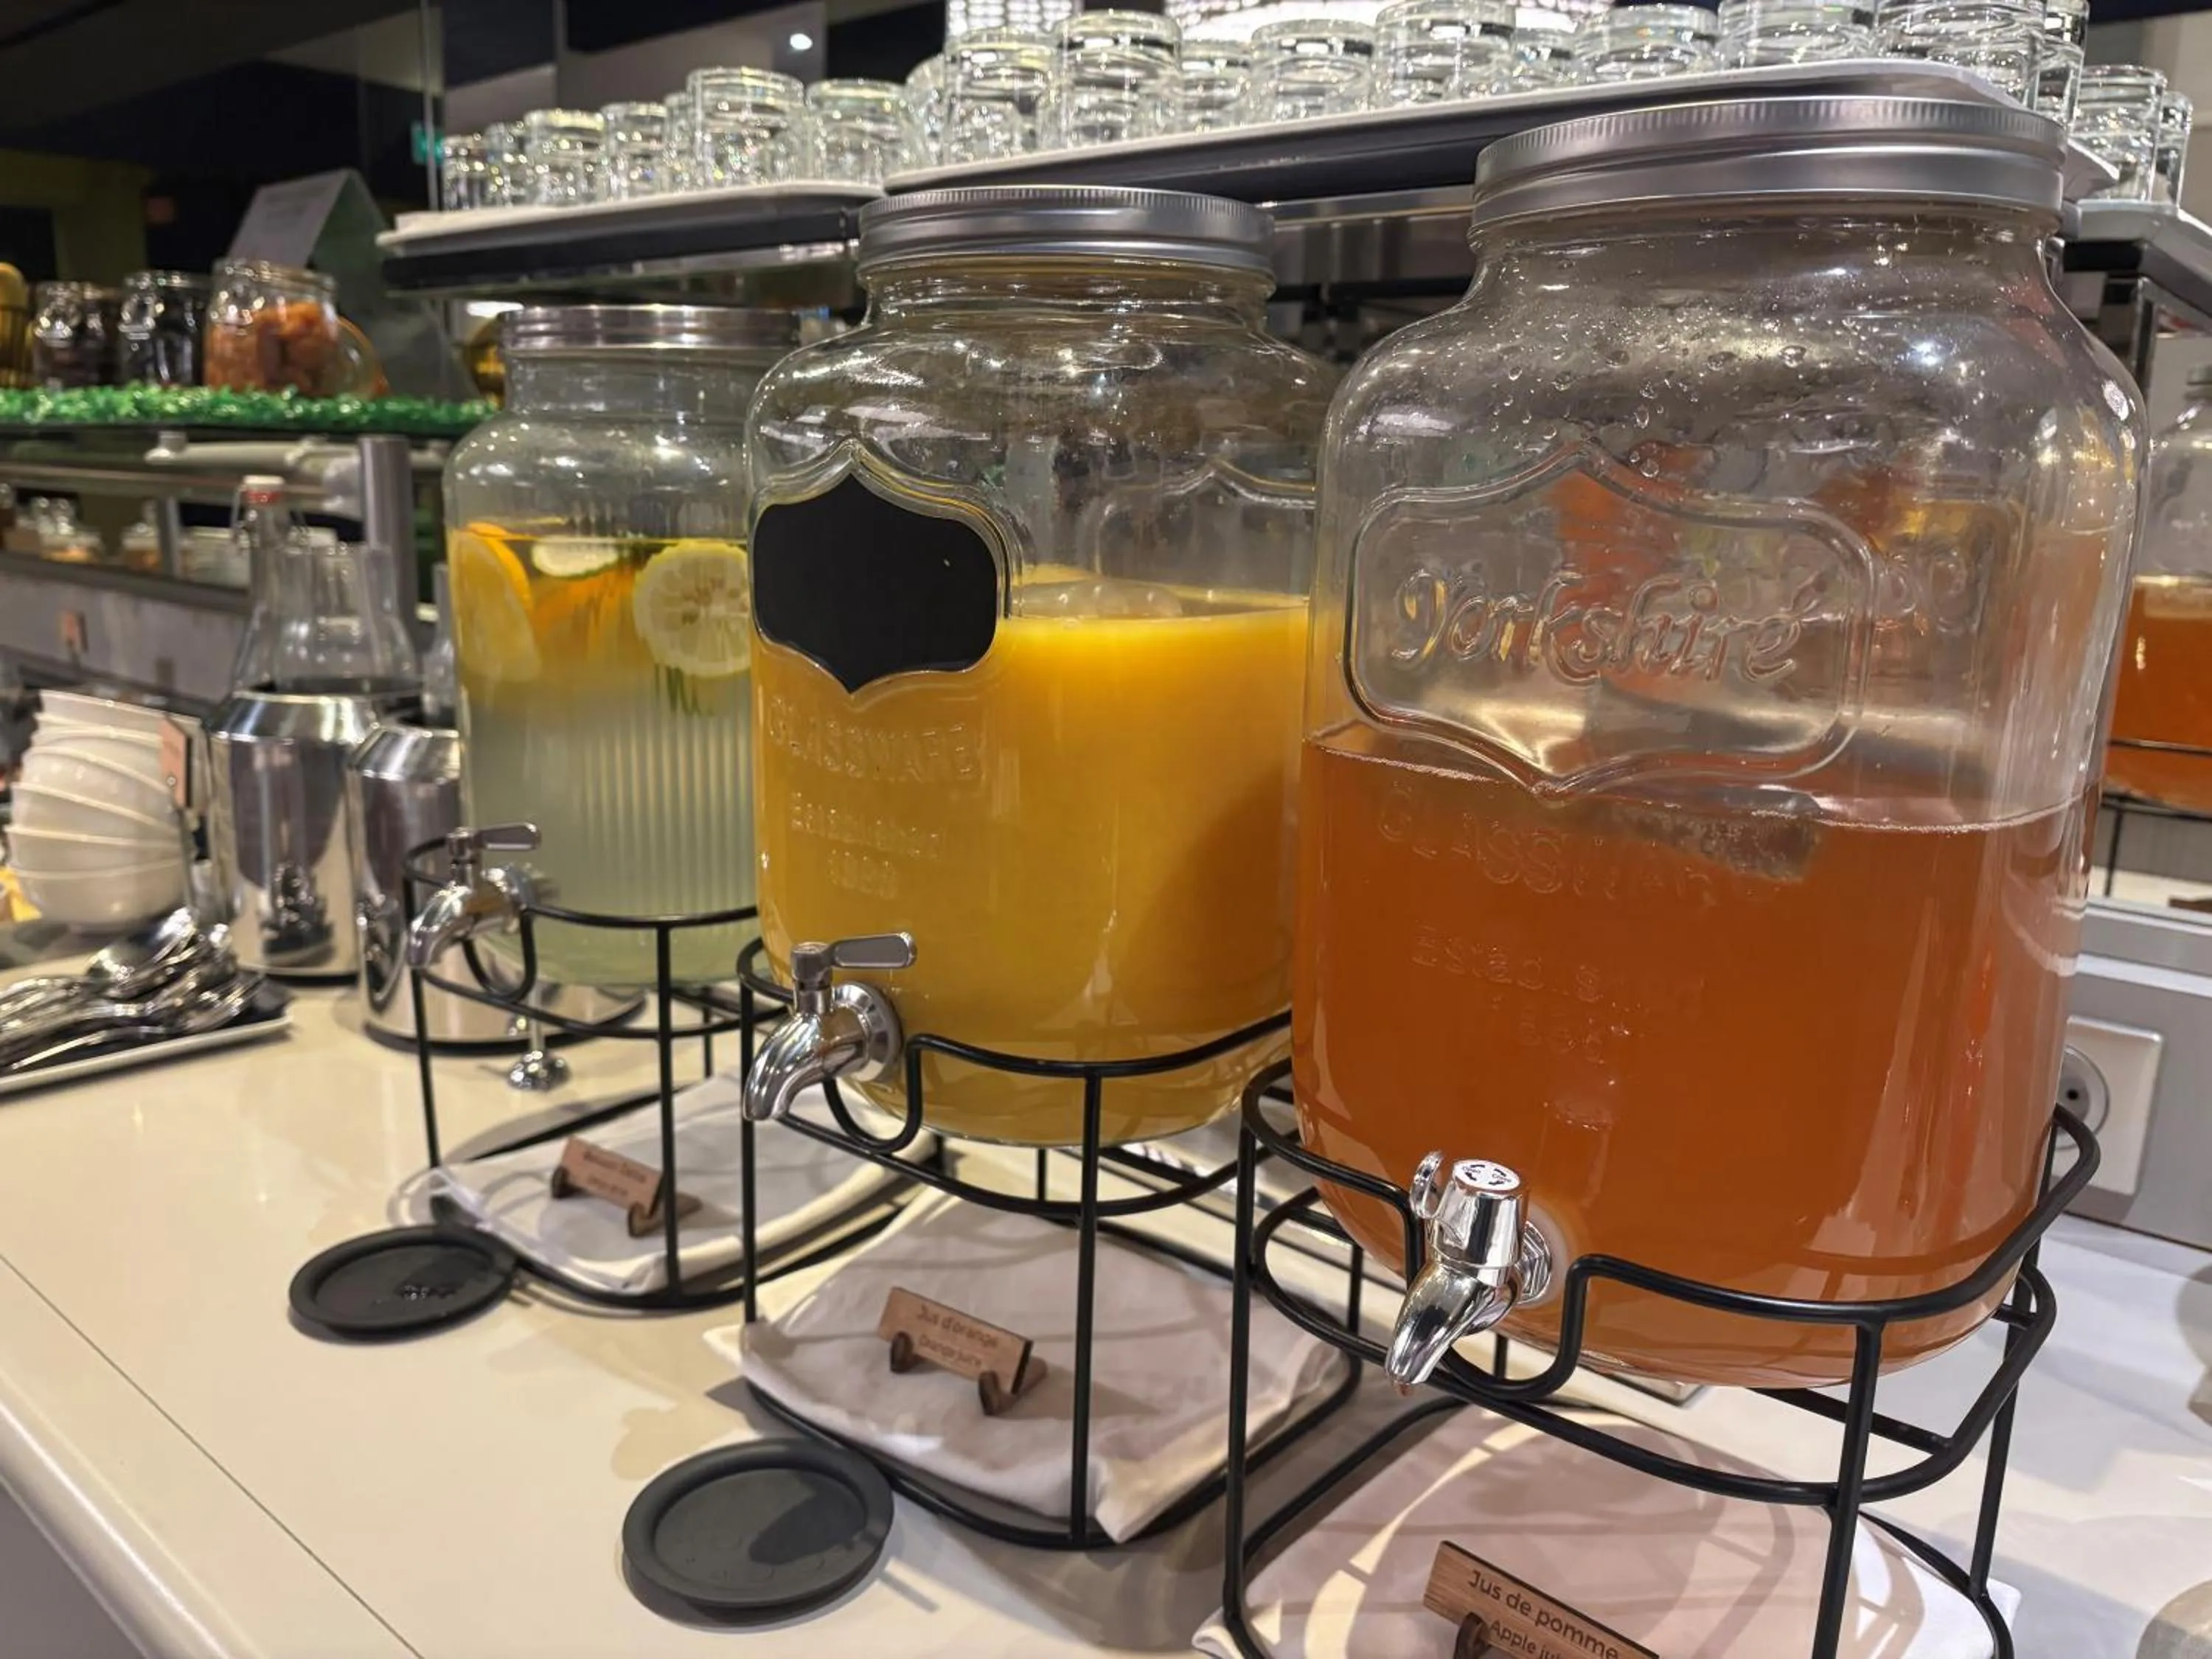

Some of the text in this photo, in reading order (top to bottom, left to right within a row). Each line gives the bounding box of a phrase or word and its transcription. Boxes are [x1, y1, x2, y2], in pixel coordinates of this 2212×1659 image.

[1467, 1571, 1618, 1659] Jus de pomme
[1489, 1619, 1537, 1655] Apple
